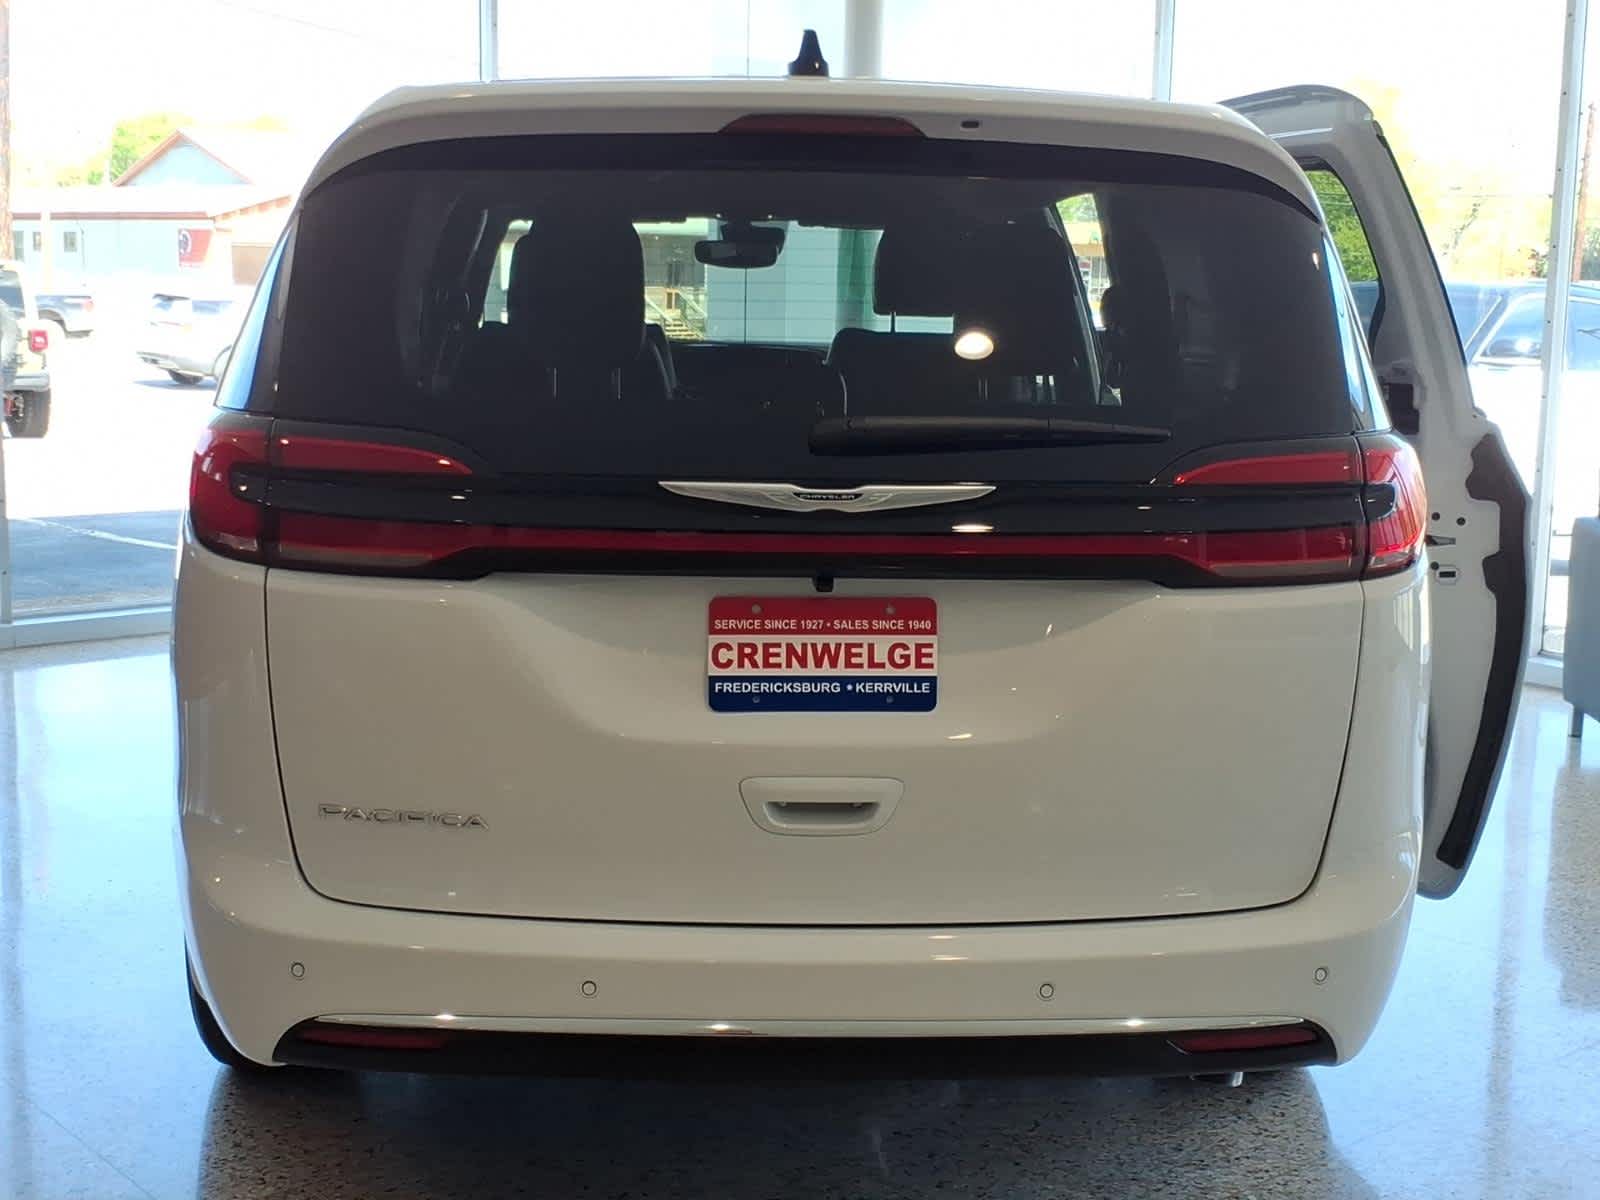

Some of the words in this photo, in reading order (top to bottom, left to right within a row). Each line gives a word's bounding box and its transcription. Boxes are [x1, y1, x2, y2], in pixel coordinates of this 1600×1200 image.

[714, 619, 761, 630] SERVICE
[764, 619, 797, 630] SINCE
[800, 619, 824, 630] 1927
[833, 619, 869, 630] SALES
[871, 619, 904, 630] SINCE
[907, 620, 932, 630] 1940
[711, 642, 935, 670] CRENWELGE
[715, 682, 841, 694] FREDERICKSBURG
[855, 682, 930, 694] KERRVILLE
[319, 803, 488, 830] PACIFICA
